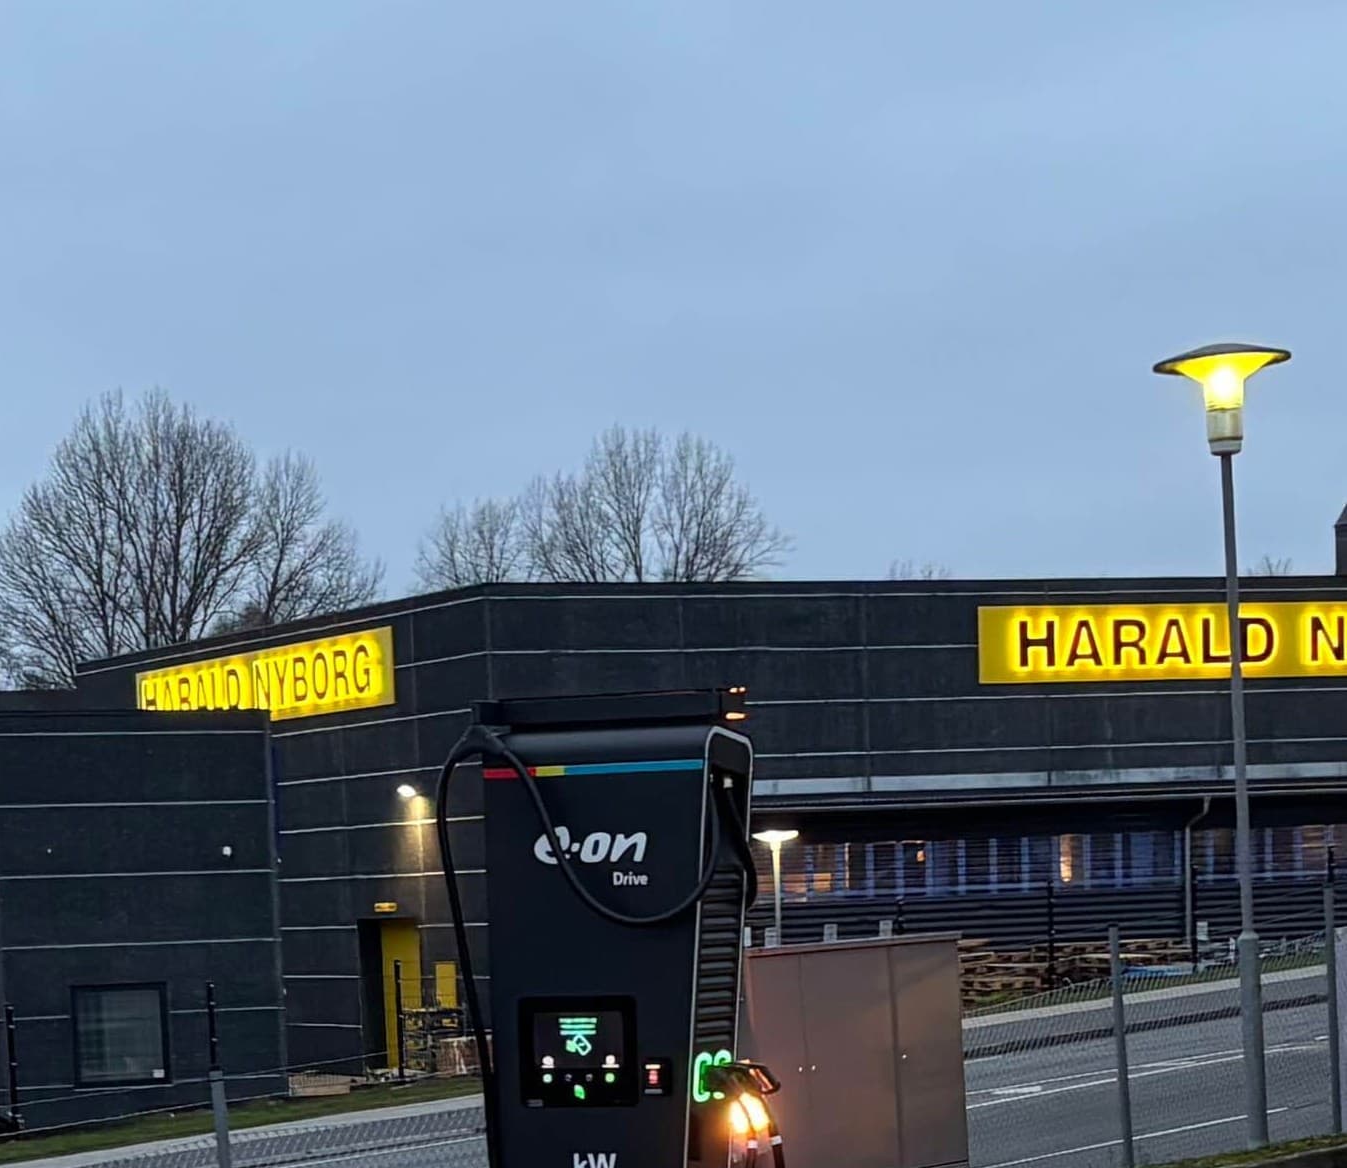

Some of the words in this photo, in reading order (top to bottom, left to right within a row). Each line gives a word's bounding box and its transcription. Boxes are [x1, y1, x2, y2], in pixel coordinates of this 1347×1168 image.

[1018, 616, 1275, 668] HARALD
[255, 644, 371, 709] NYBORG
[612, 870, 649, 886] Drive
